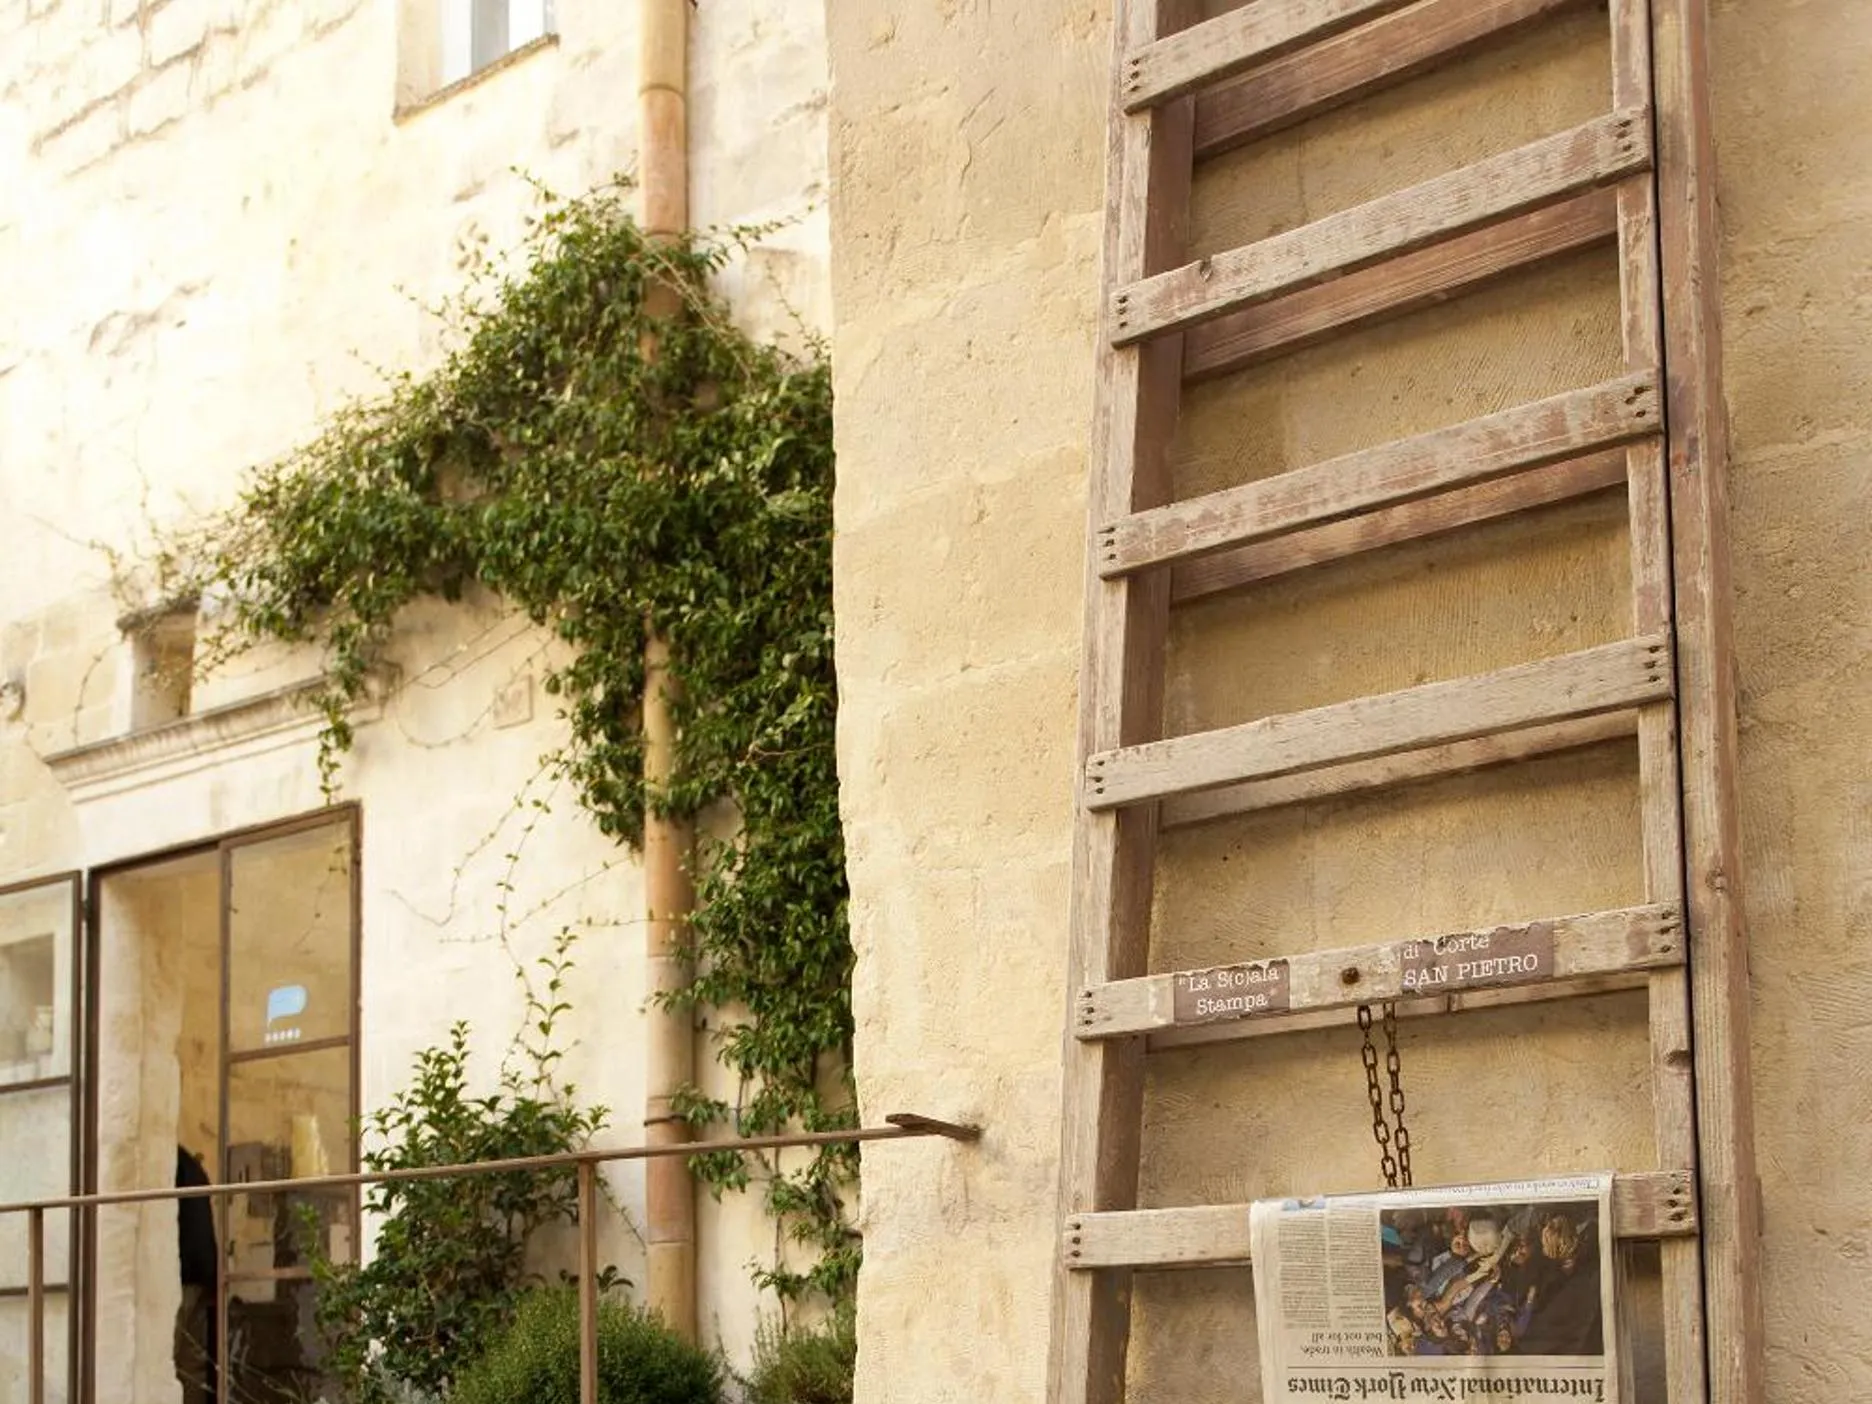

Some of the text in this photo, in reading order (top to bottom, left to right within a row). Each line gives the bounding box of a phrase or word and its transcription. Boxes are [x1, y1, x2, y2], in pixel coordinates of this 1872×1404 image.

[1403, 935, 1489, 959] di Corte
[1218, 966, 1279, 988] S(c)ala
[1404, 954, 1538, 986] SAN PIETRO
[1287, 1372, 1604, 1402] International New York Times
